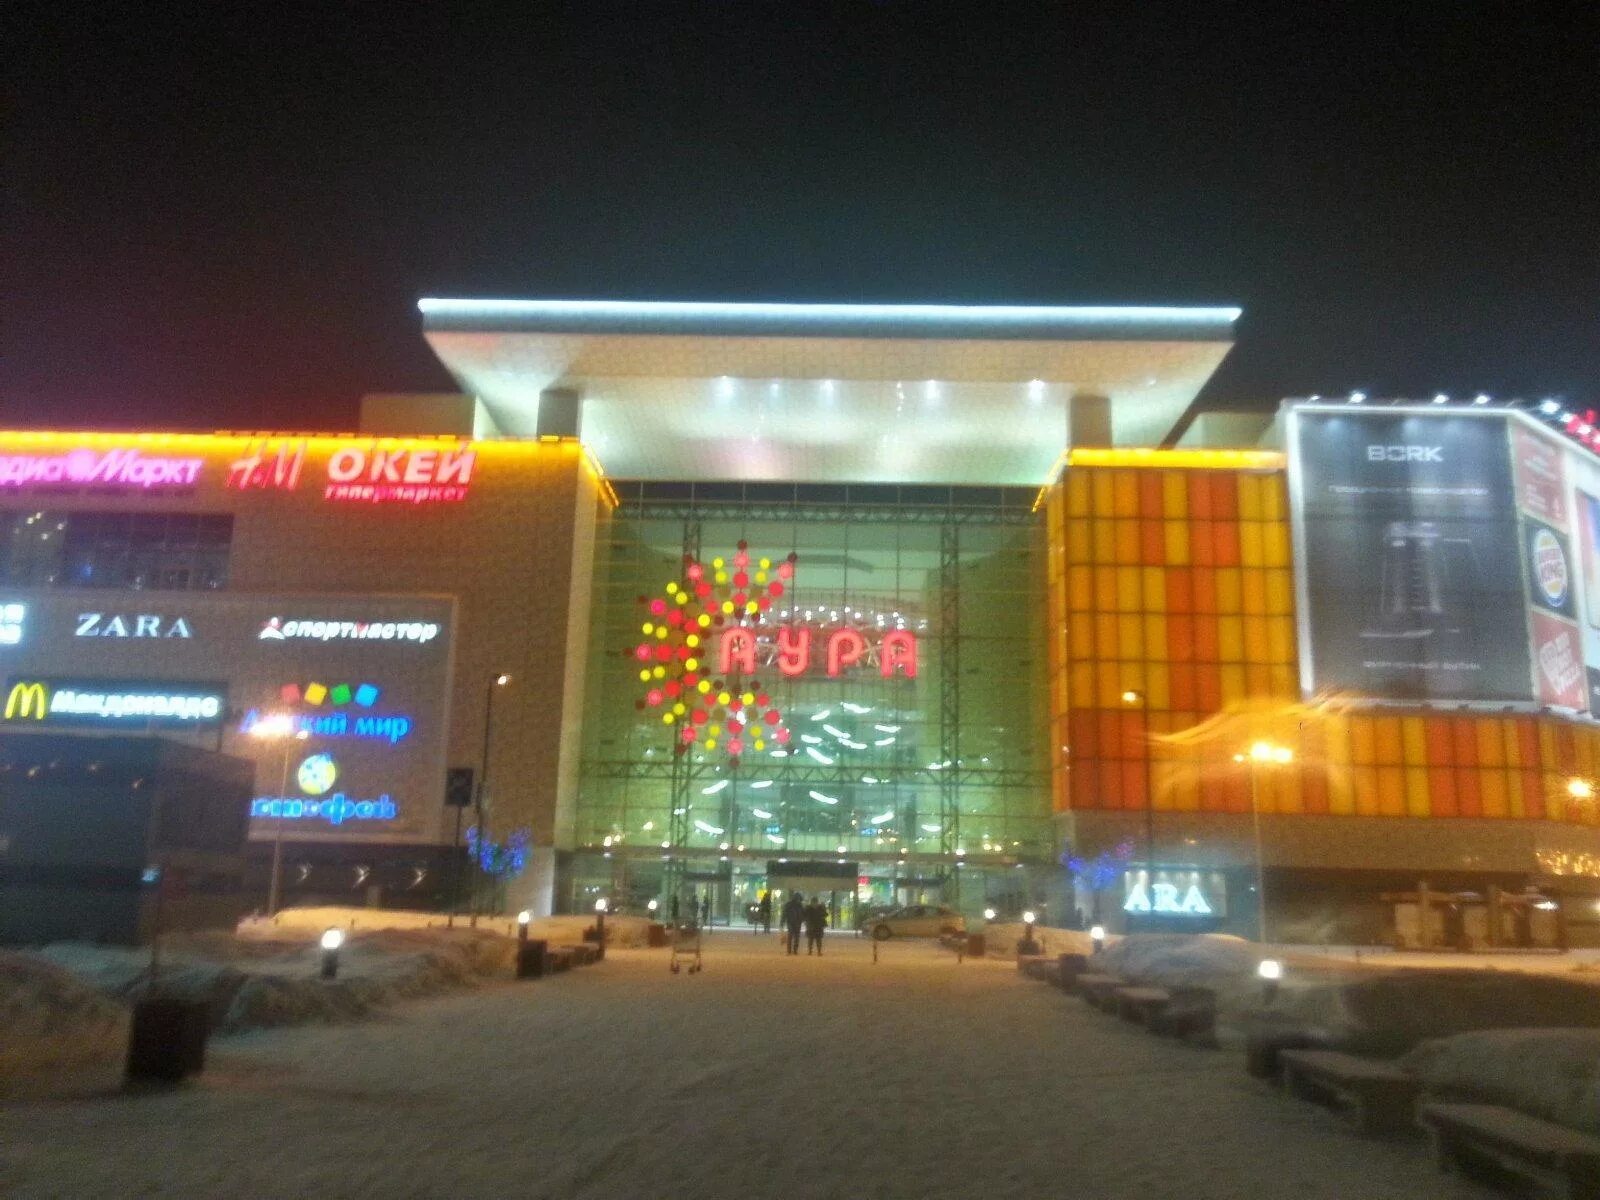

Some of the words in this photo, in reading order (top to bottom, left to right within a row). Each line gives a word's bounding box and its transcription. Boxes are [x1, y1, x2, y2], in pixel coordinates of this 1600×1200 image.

[1367, 445, 1444, 463] BORK
[0, 456, 66, 486] диа
[74, 612, 193, 639] ZARA
[719, 626, 919, 679] АУРА
[354, 716, 410, 746] мир
